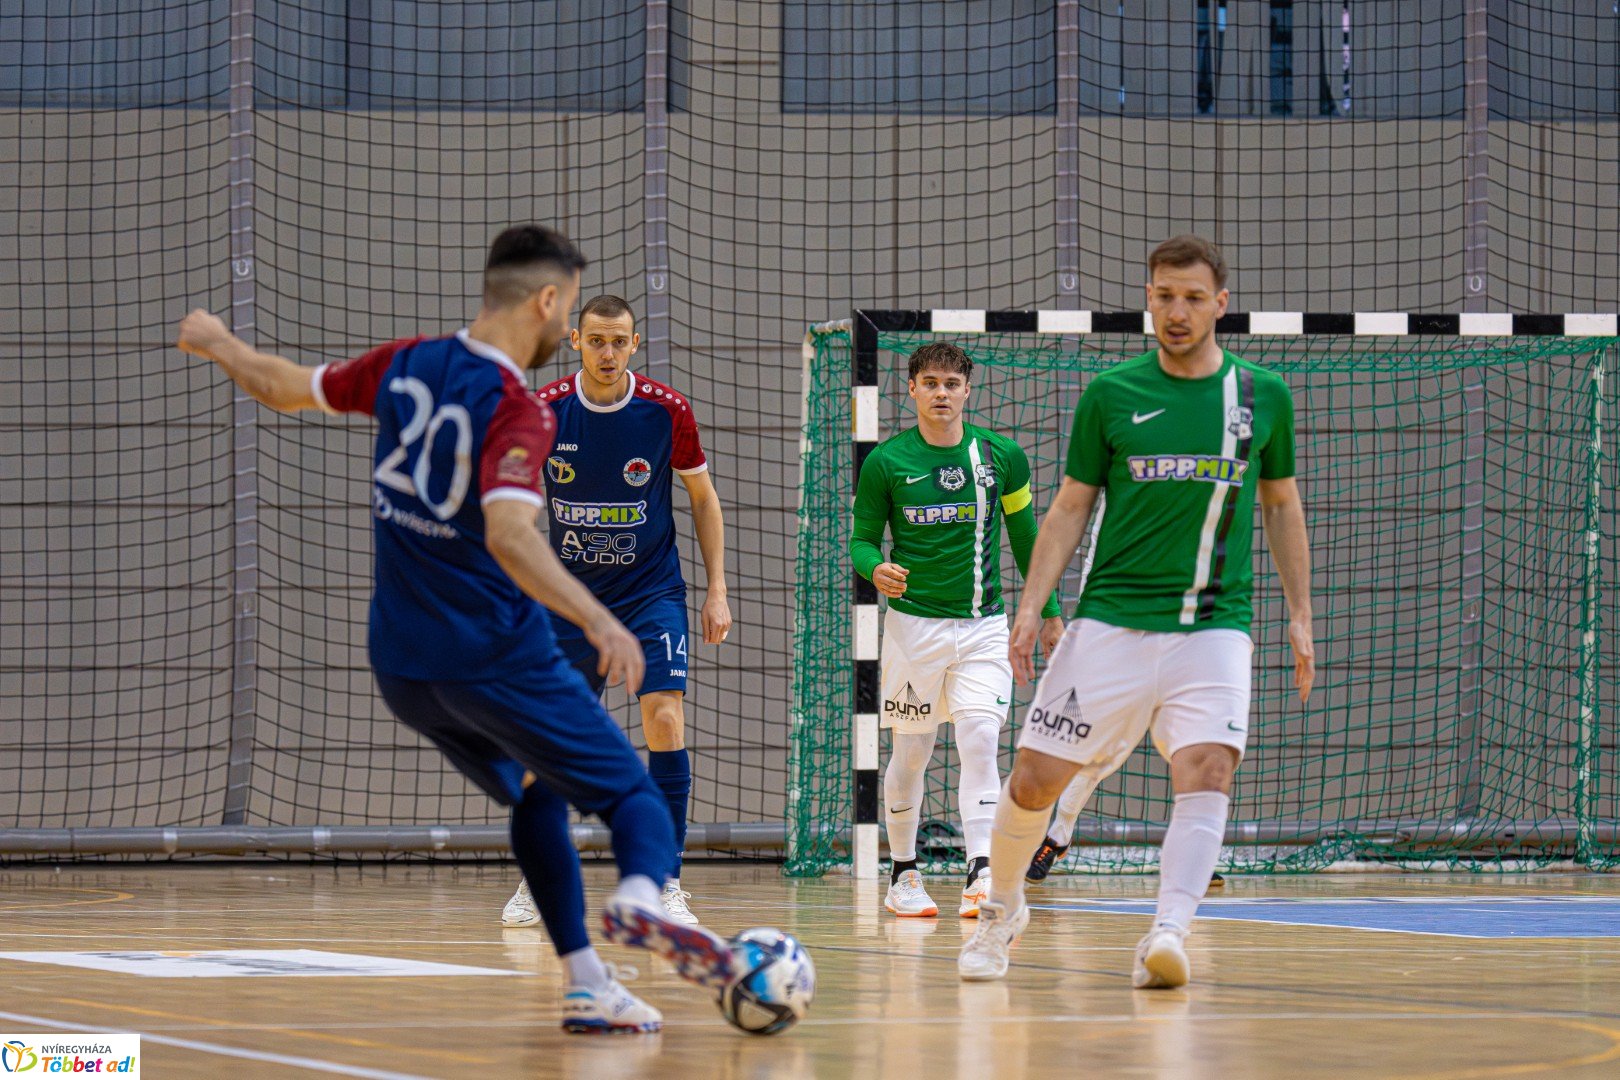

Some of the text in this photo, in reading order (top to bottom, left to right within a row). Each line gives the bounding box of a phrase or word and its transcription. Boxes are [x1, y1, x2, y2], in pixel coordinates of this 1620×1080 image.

[375, 376, 473, 521] 20
[556, 443, 578, 452] JAKO
[554, 500, 646, 525] TiPPMIX
[904, 502, 991, 523] TiPPM
[561, 547, 636, 565] STUDIO
[659, 632, 687, 664] 14
[889, 712, 927, 721] ASZFALT
